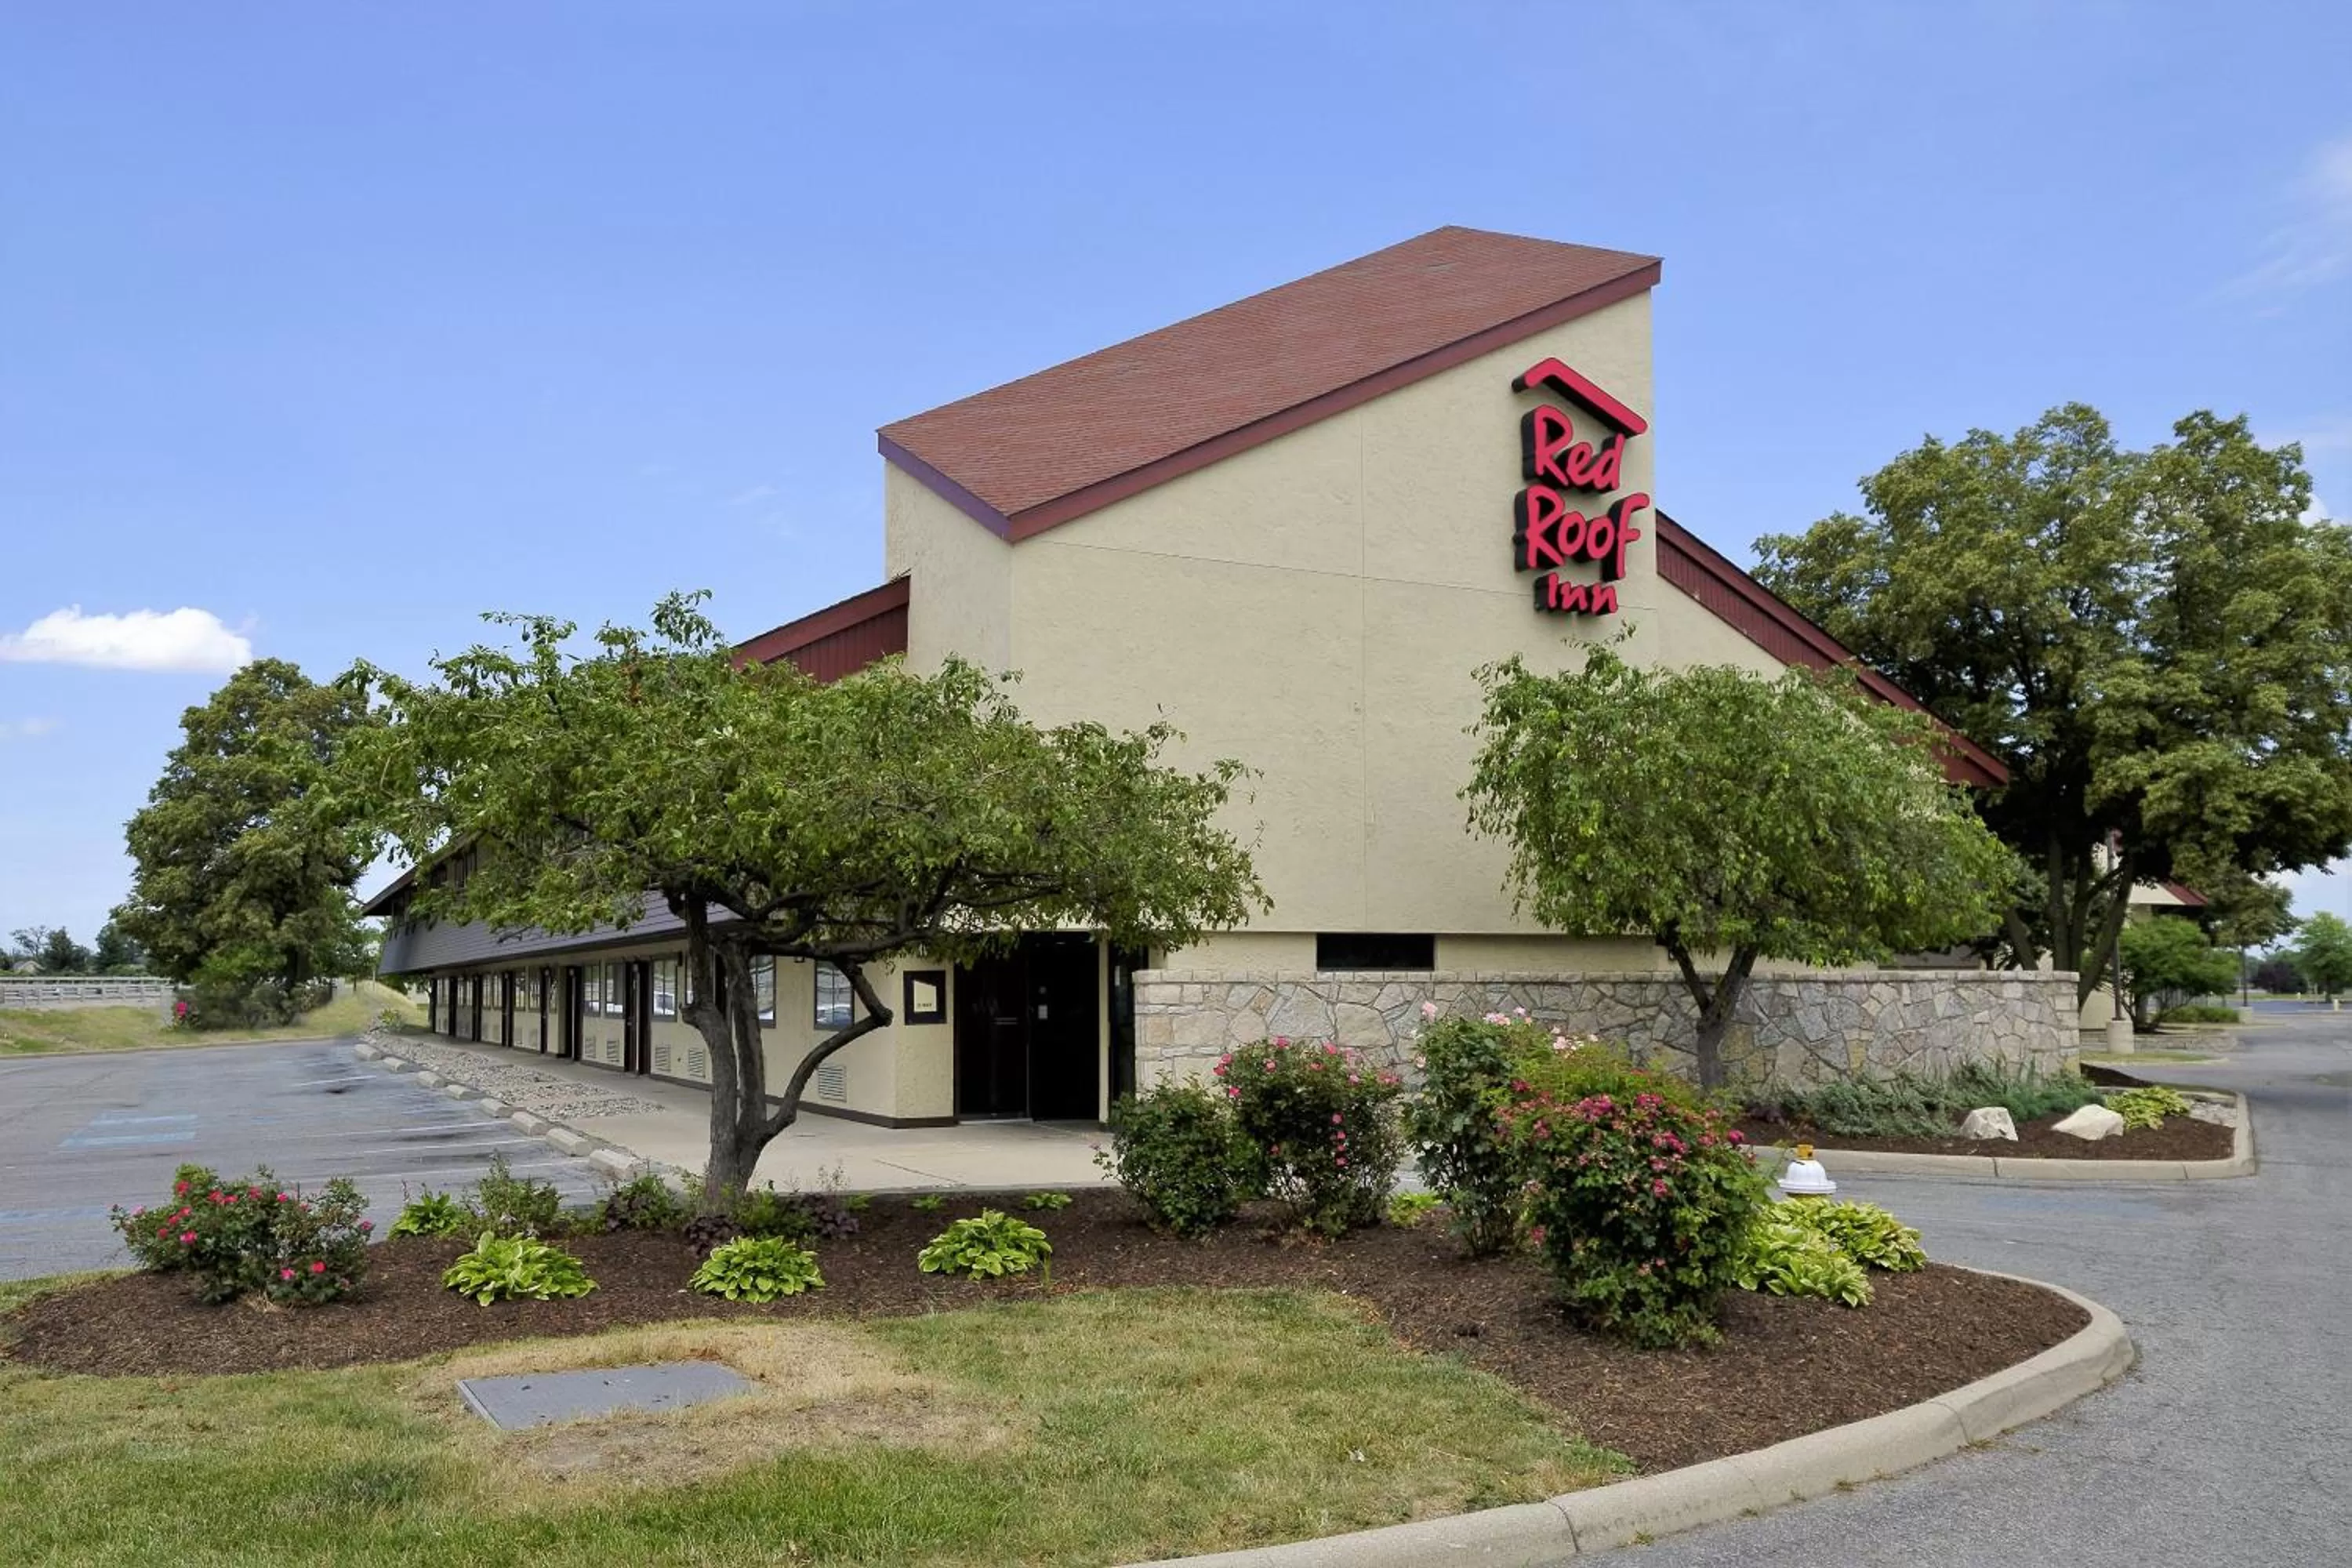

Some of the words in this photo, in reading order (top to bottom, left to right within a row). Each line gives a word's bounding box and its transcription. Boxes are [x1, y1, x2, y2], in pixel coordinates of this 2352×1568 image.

[1533, 405, 1625, 491] Red
[1524, 484, 1650, 580] Roof
[1547, 572, 1619, 614] Inn
